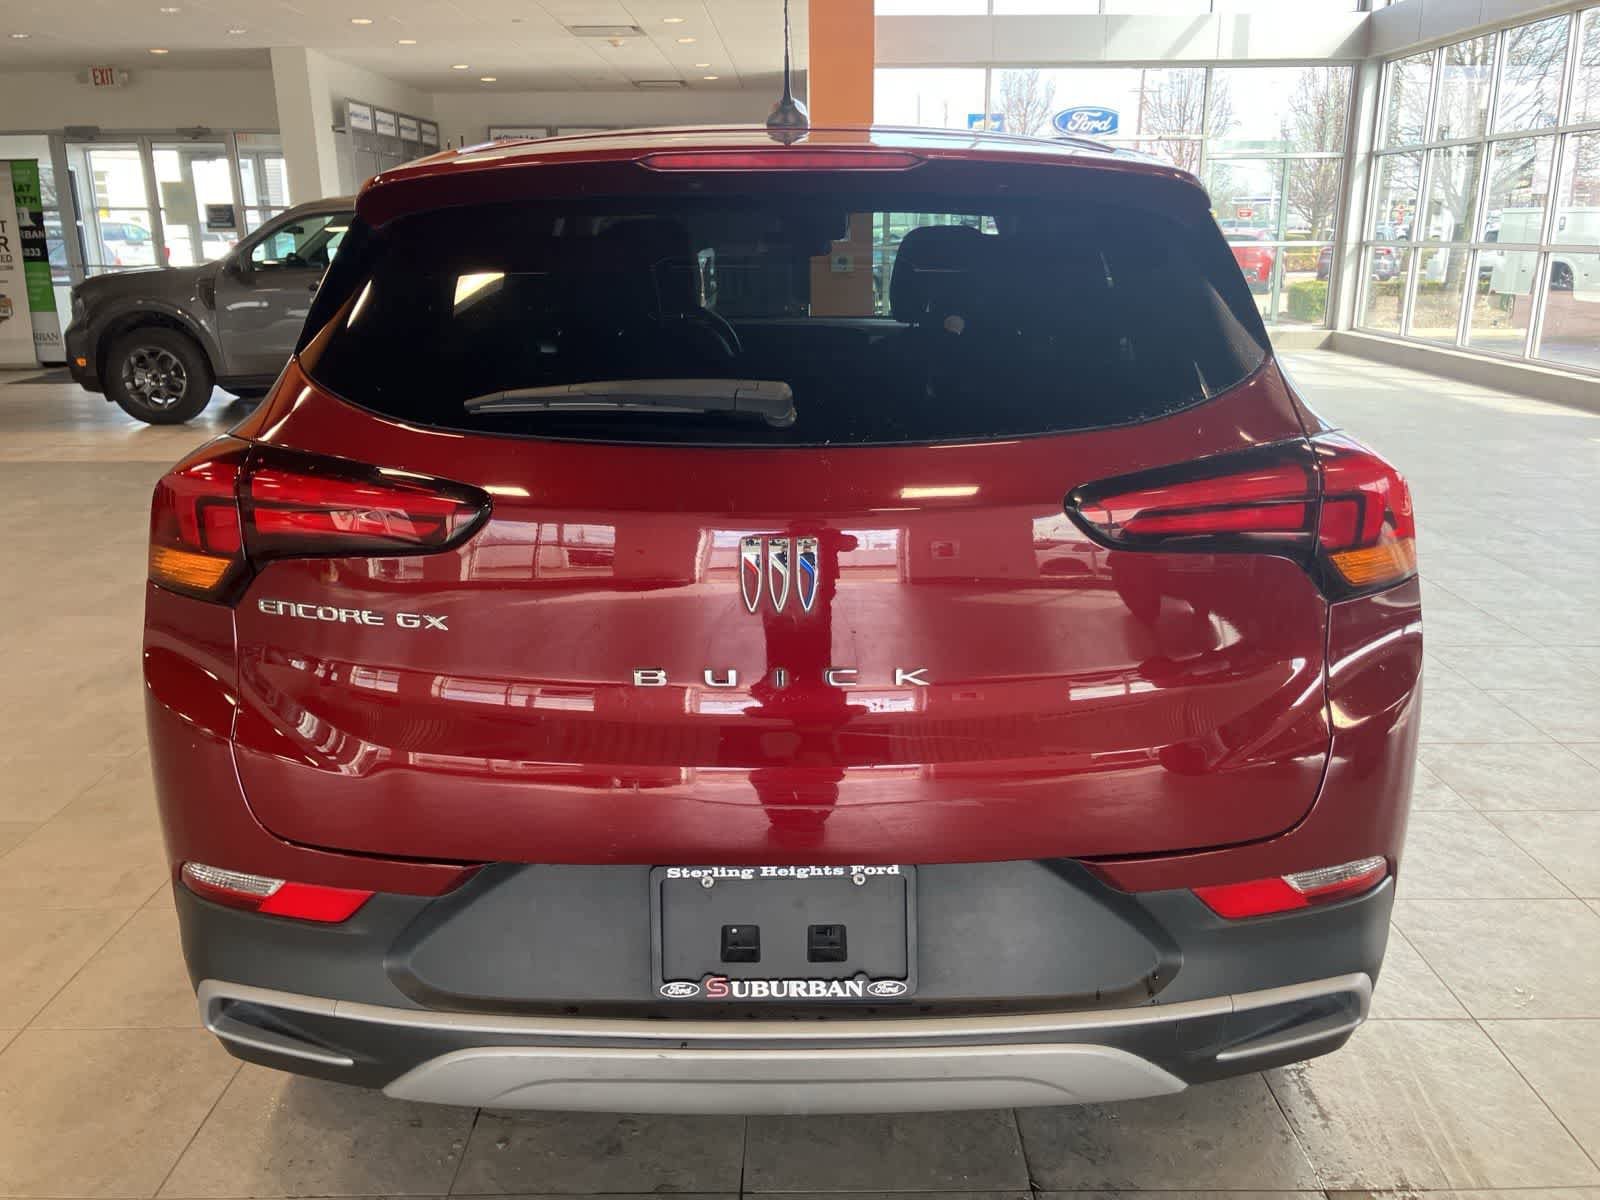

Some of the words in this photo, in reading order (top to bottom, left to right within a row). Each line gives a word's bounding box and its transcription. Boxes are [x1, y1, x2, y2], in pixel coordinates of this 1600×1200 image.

[92, 67, 114, 86] EXIT
[1068, 112, 1112, 131] Ford
[258, 599, 384, 626] ENCORE
[396, 613, 449, 631] GX
[633, 668, 930, 687] BUICK
[667, 867, 754, 879] Sterling
[759, 866, 844, 878] Heights
[850, 865, 900, 876] Ford
[667, 984, 692, 995] Ford
[706, 977, 864, 997] SUBURBAN
[874, 982, 899, 993] Ford
